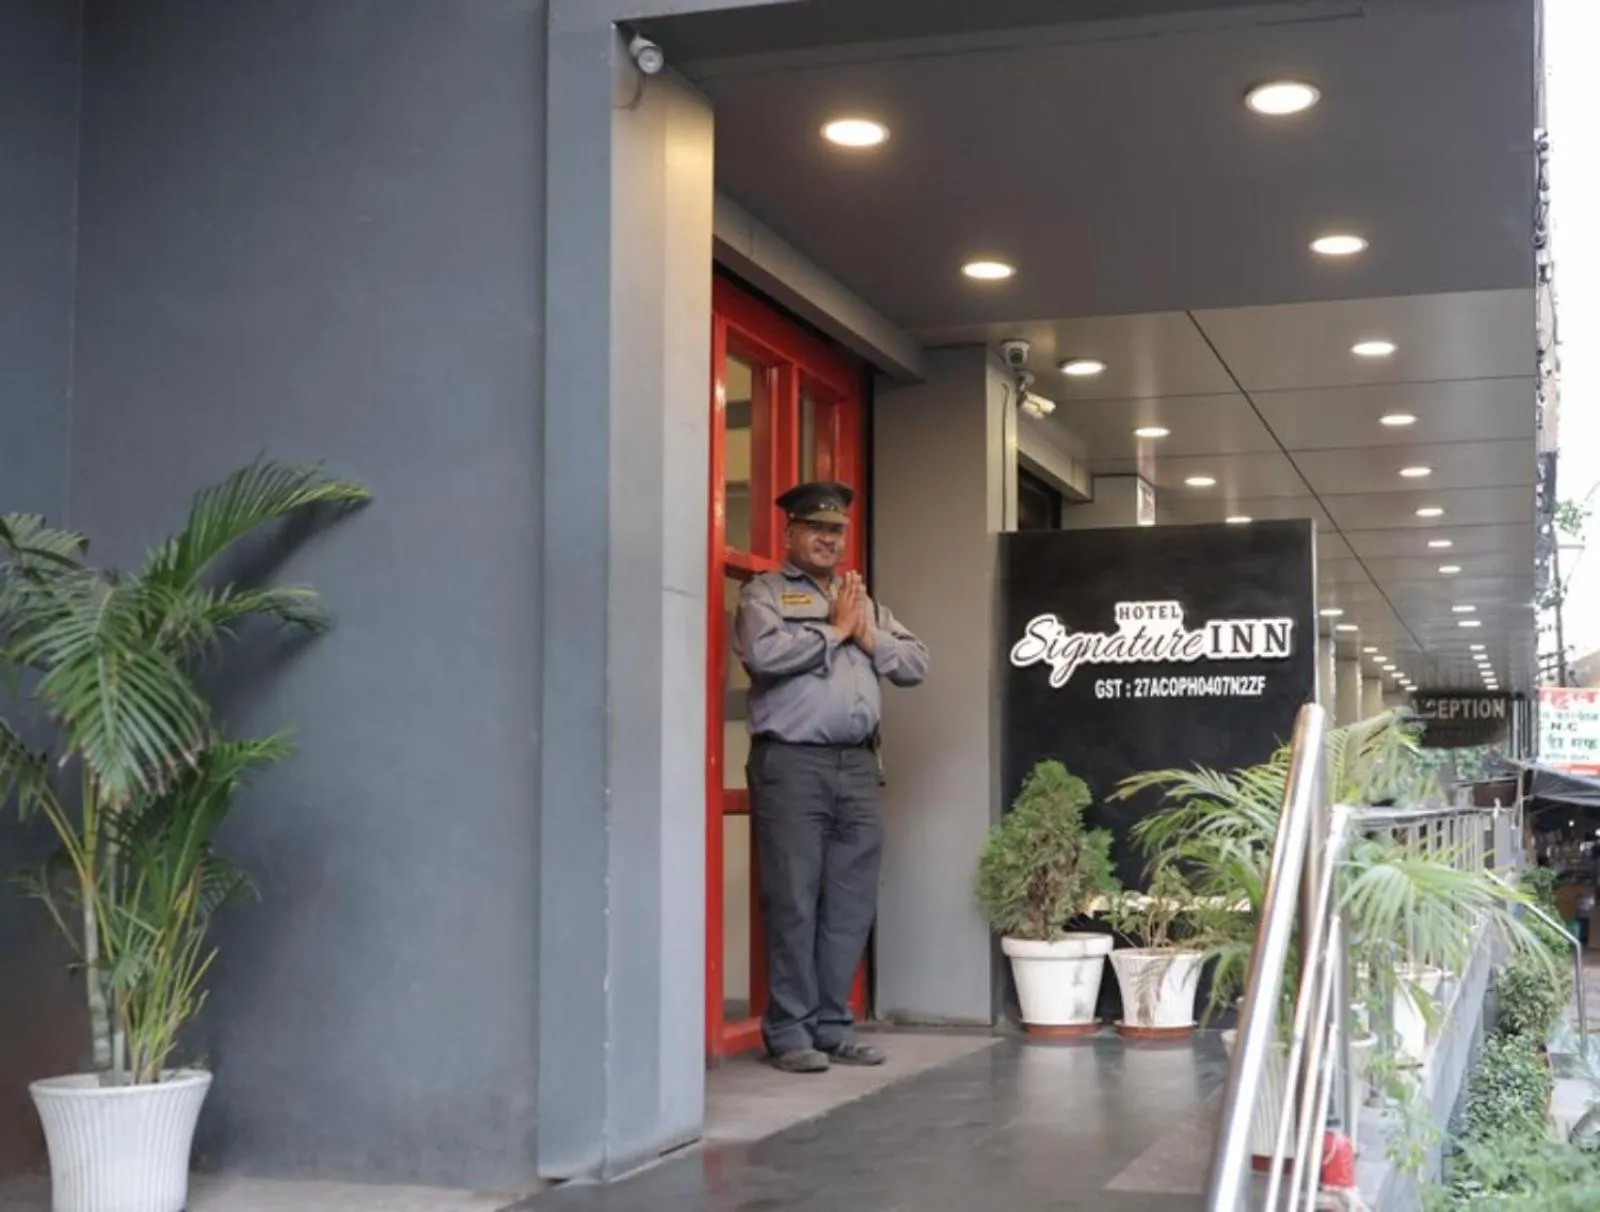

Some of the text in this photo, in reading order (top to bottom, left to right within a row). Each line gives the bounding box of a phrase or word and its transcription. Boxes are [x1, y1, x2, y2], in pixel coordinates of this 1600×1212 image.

[1118, 604, 1181, 621] HOTEL
[1013, 617, 1290, 685] Signature INN
[1094, 678, 1123, 699] GST
[1411, 698, 1506, 719] CEPTION
